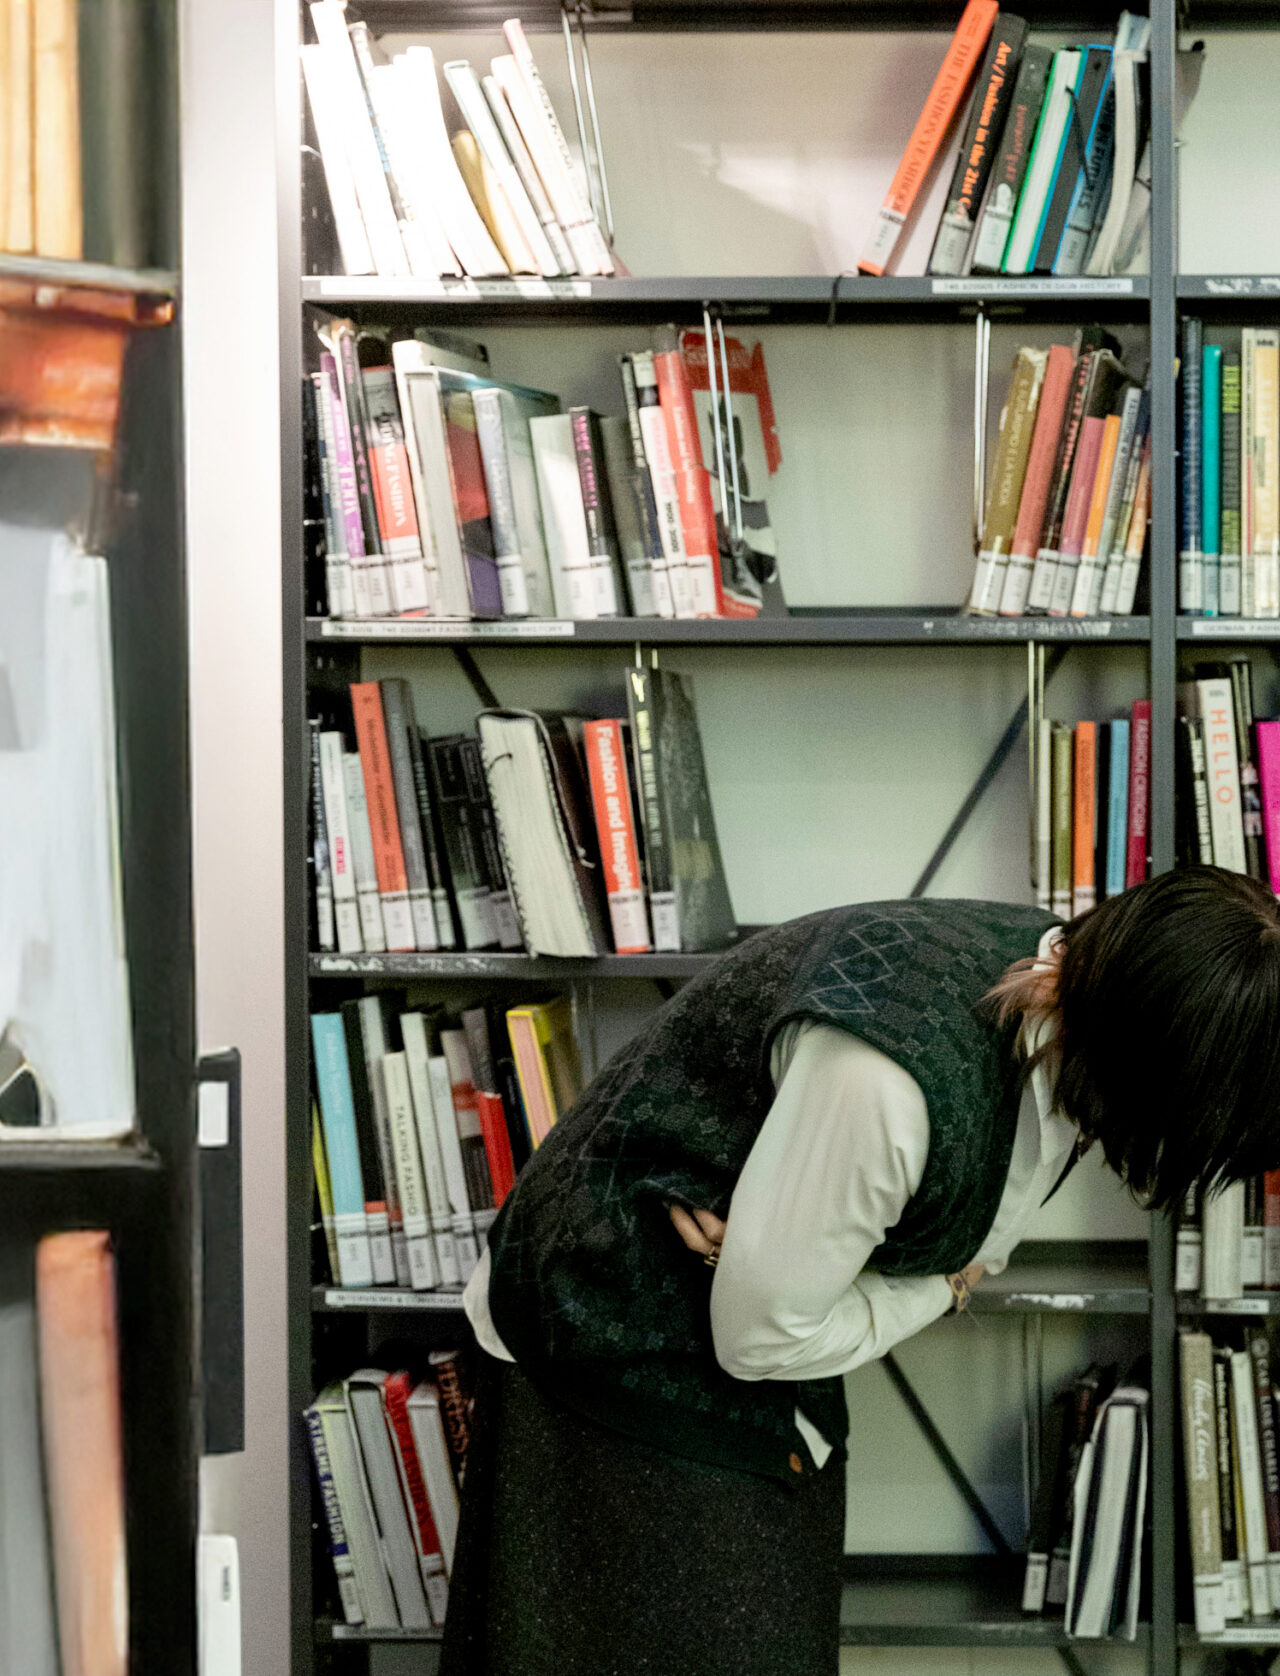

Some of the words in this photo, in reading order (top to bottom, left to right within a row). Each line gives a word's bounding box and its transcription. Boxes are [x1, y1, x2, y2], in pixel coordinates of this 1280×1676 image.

[949, 41, 971, 72] THE
[923, 71, 959, 135] FASHION
[967, 143, 986, 167] the
[974, 127, 990, 144] in
[960, 167, 980, 195] 21st
[595, 725, 621, 793] Fashion
[1134, 718, 1148, 773] FASHION
[1206, 708, 1236, 804] HELLO
[606, 795, 624, 828] and
[1131, 775, 1145, 836] CRITICISM
[391, 1105, 411, 1161] TALKING
[1262, 1429, 1280, 1492] CHARLES
[319, 1478, 347, 1544] FASHION
